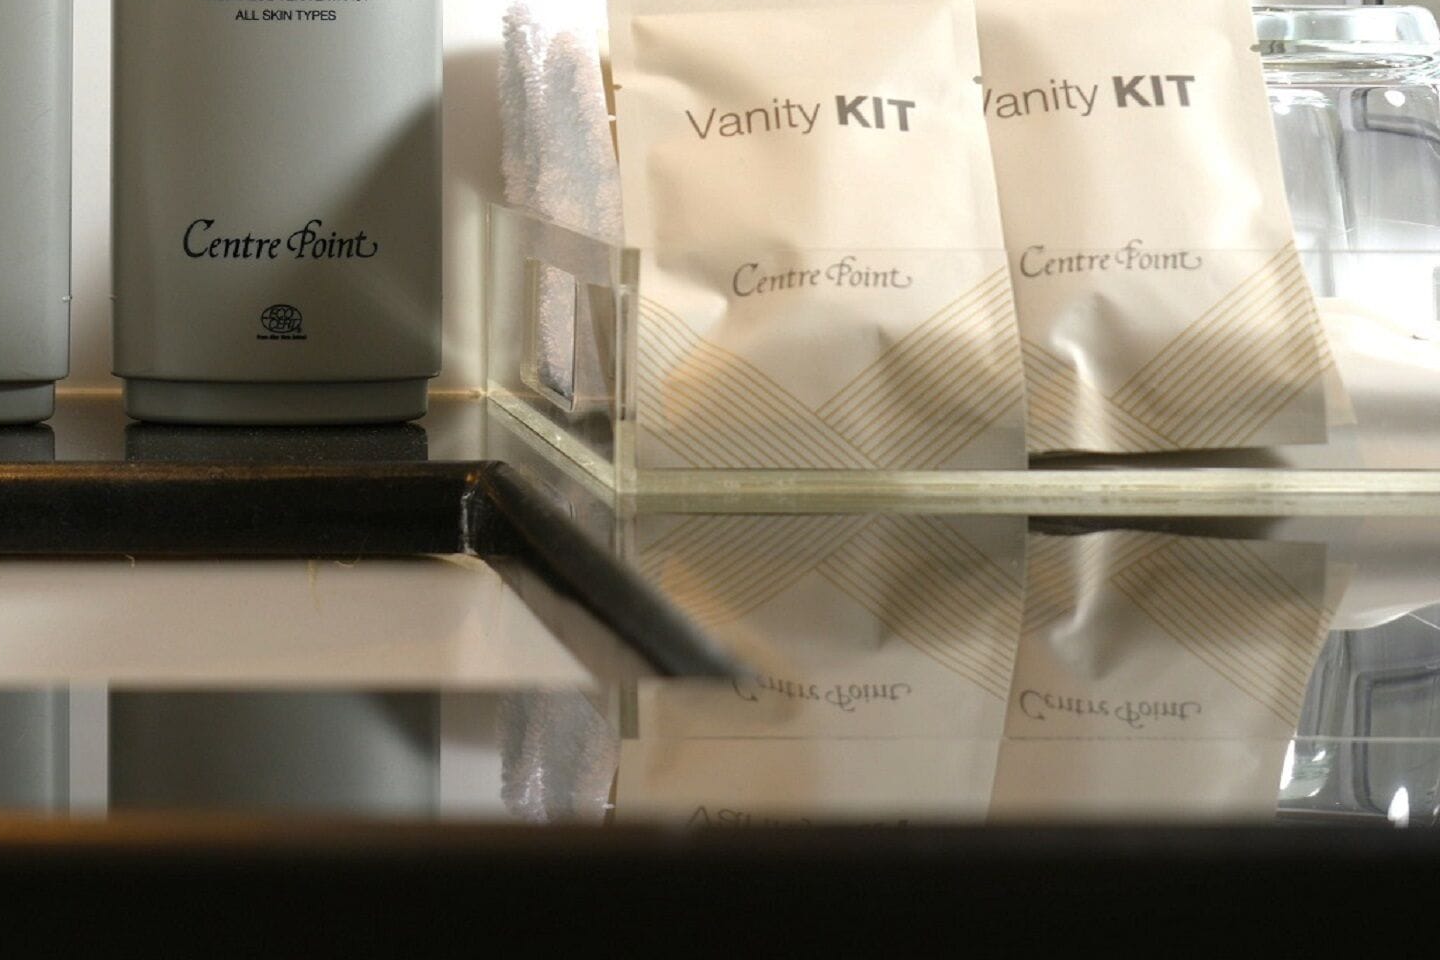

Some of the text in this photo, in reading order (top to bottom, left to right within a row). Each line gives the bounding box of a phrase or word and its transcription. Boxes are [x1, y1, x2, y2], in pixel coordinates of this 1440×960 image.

[234, 9, 337, 21] ALL SKIN TYPES
[1112, 74, 1196, 108] KIT
[685, 95, 916, 140] Vanity KIT
[183, 218, 379, 260] Centre Point
[1020, 238, 1203, 278] Centre Point
[732, 255, 913, 297] Centre Point
